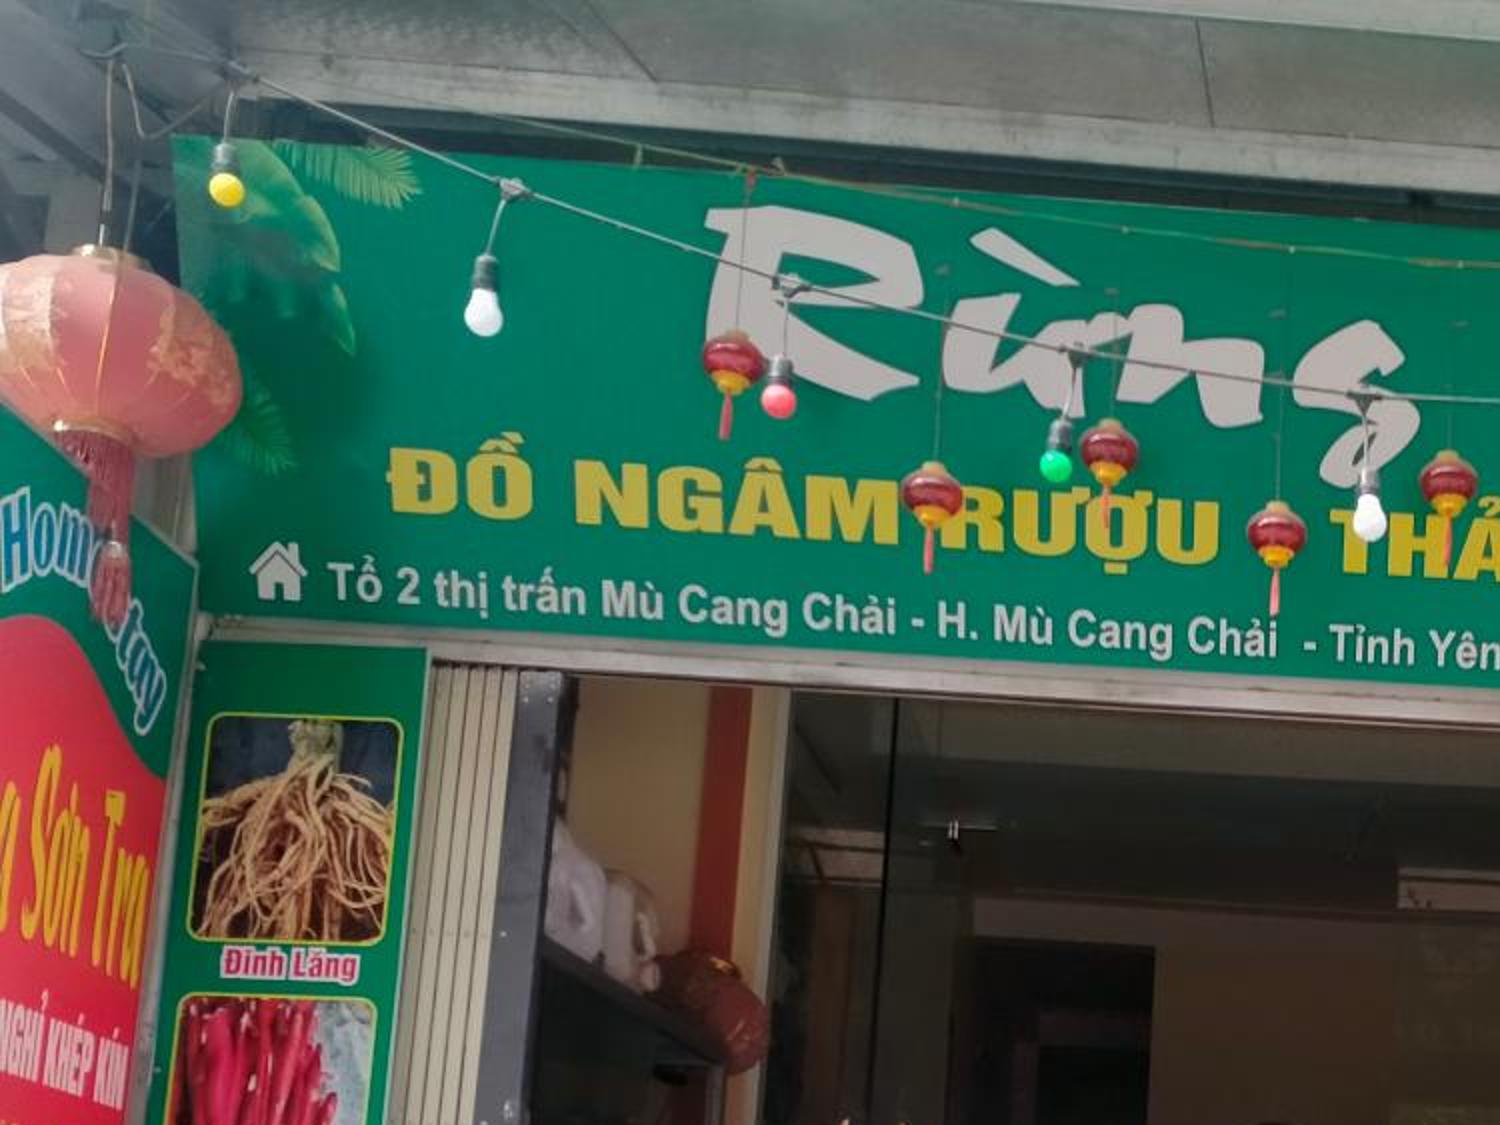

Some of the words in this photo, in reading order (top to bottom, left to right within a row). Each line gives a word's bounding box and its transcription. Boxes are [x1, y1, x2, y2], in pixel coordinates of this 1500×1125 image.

[387, 432, 534, 519] ĐỒ
[575, 457, 900, 546] NGÂM
[941, 481, 1220, 574] RƯỢU
[327, 555, 383, 602] Tổ
[397, 566, 421, 605] 2
[434, 569, 489, 619] thị
[502, 566, 587, 616] trấn
[601, 580, 664, 620] Mù
[678, 584, 788, 638] Cang
[802, 592, 897, 635] Chải
[938, 602, 978, 640] H.
[994, 604, 1053, 645] Mù
[1068, 609, 1173, 661] Cang
[1187, 616, 1277, 658] Chải
[1329, 623, 1416, 666] Tỉnh
